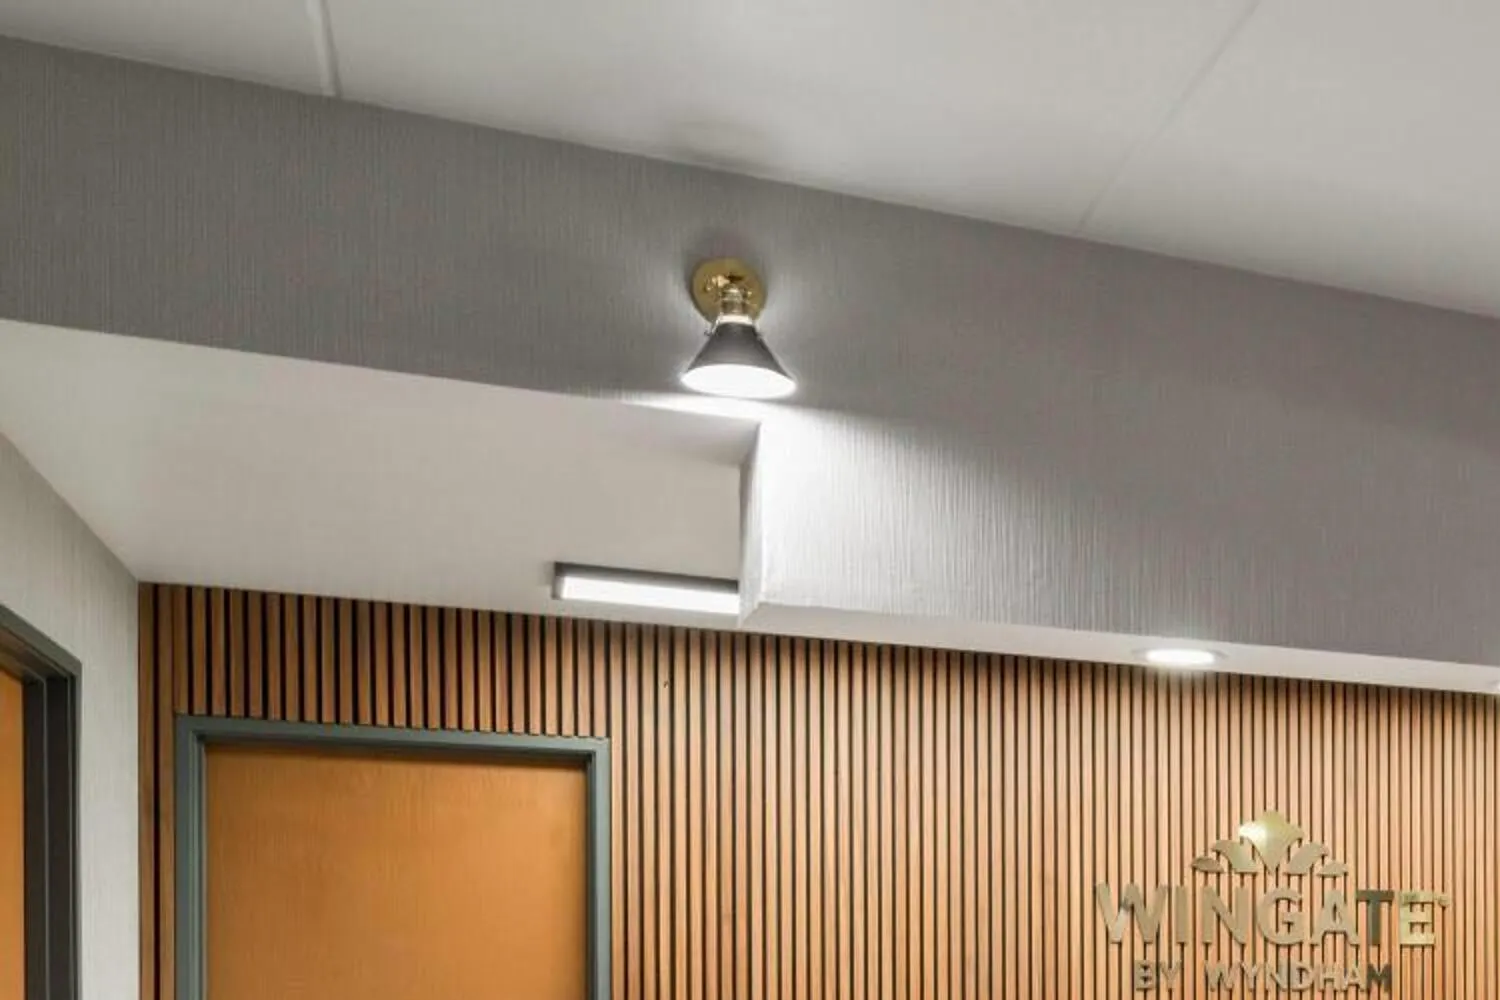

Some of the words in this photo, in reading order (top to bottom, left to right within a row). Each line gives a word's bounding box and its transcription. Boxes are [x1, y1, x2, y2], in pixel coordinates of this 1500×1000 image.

[1095, 882, 1435, 946] WINGATE
[1135, 960, 1180, 991] BY
[1204, 962, 1391, 993] WYNDHAM
